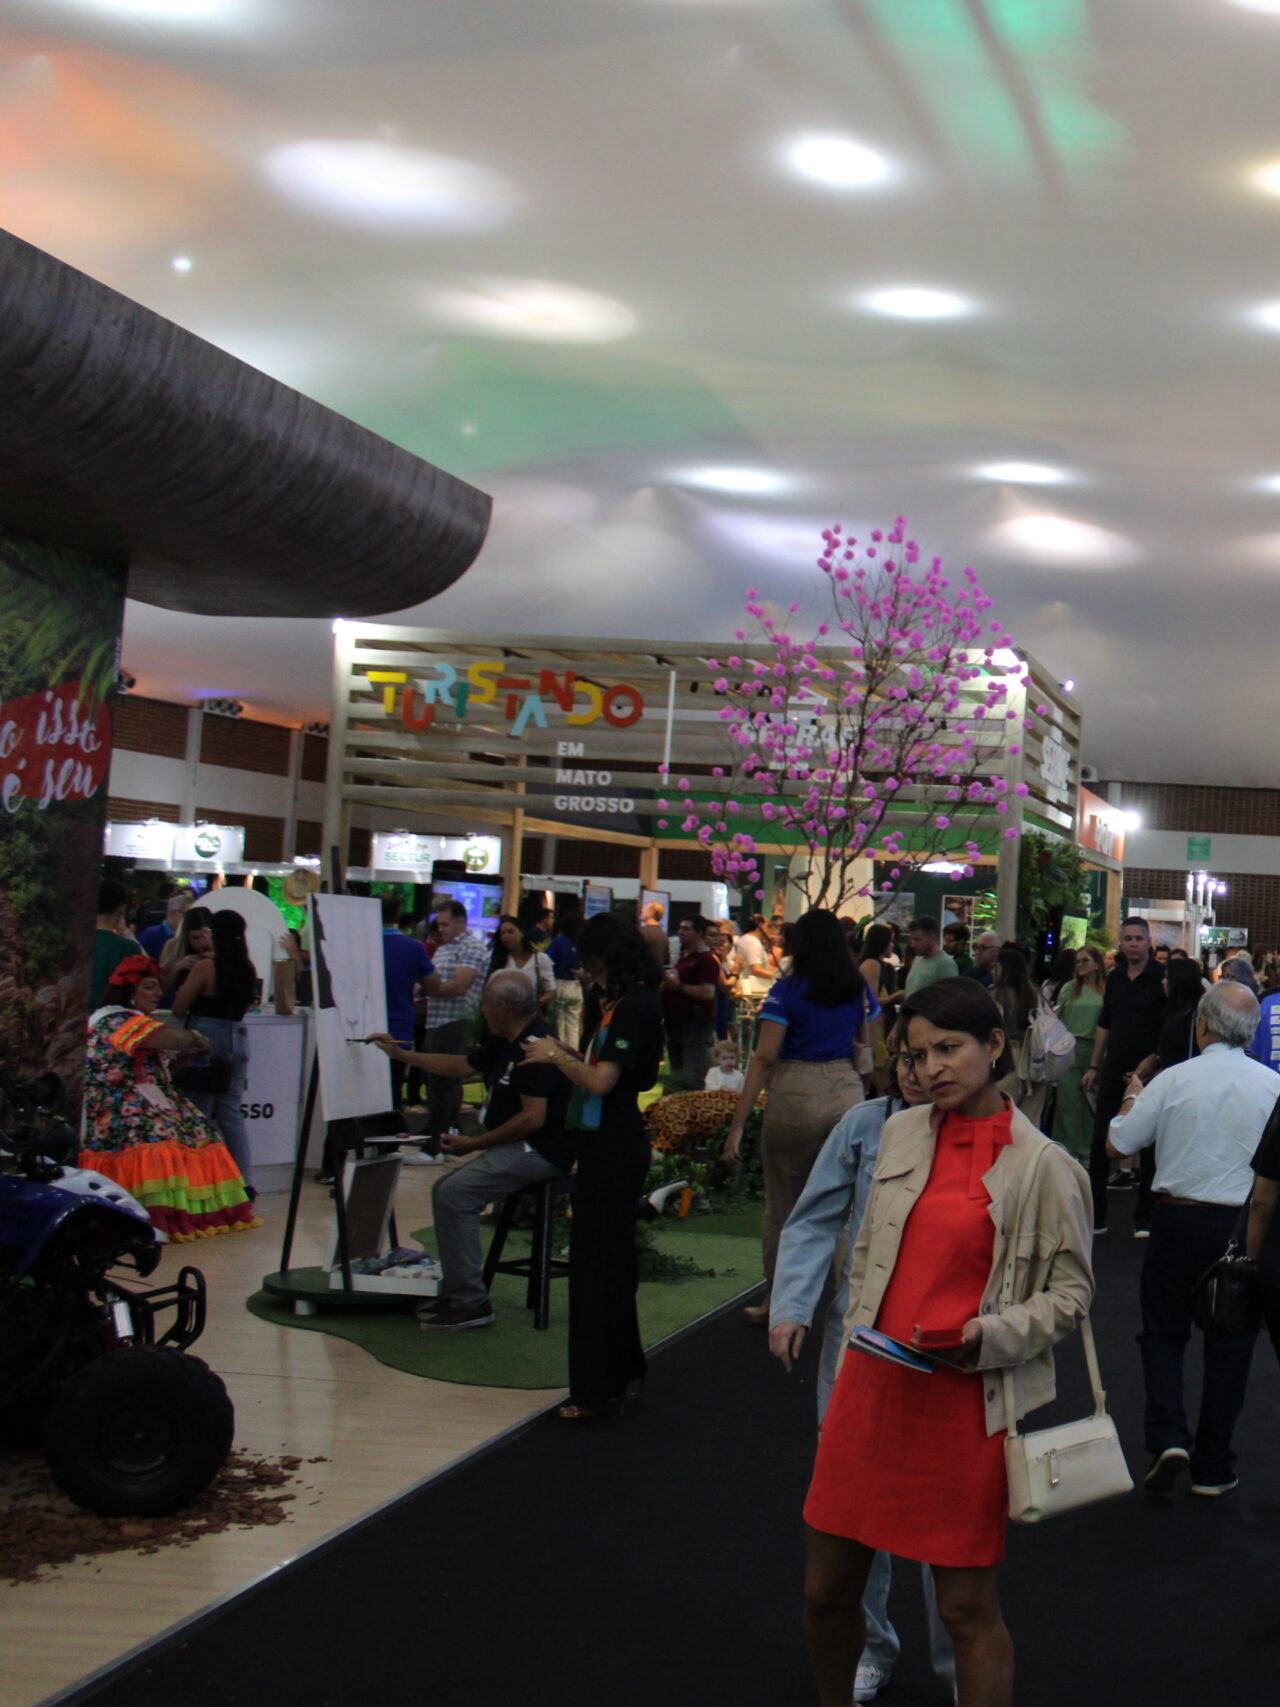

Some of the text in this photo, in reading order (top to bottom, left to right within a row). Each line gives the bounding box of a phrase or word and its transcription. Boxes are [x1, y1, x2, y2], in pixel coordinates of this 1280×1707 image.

[366, 660, 645, 737] TURISTANDO
[36, 691, 102, 752] isso
[557, 741, 584, 758] EM
[3, 758, 98, 814] é seu
[556, 768, 612, 786] MATO
[555, 796, 635, 813] GROSSO
[384, 851, 431, 863] SECTUR
